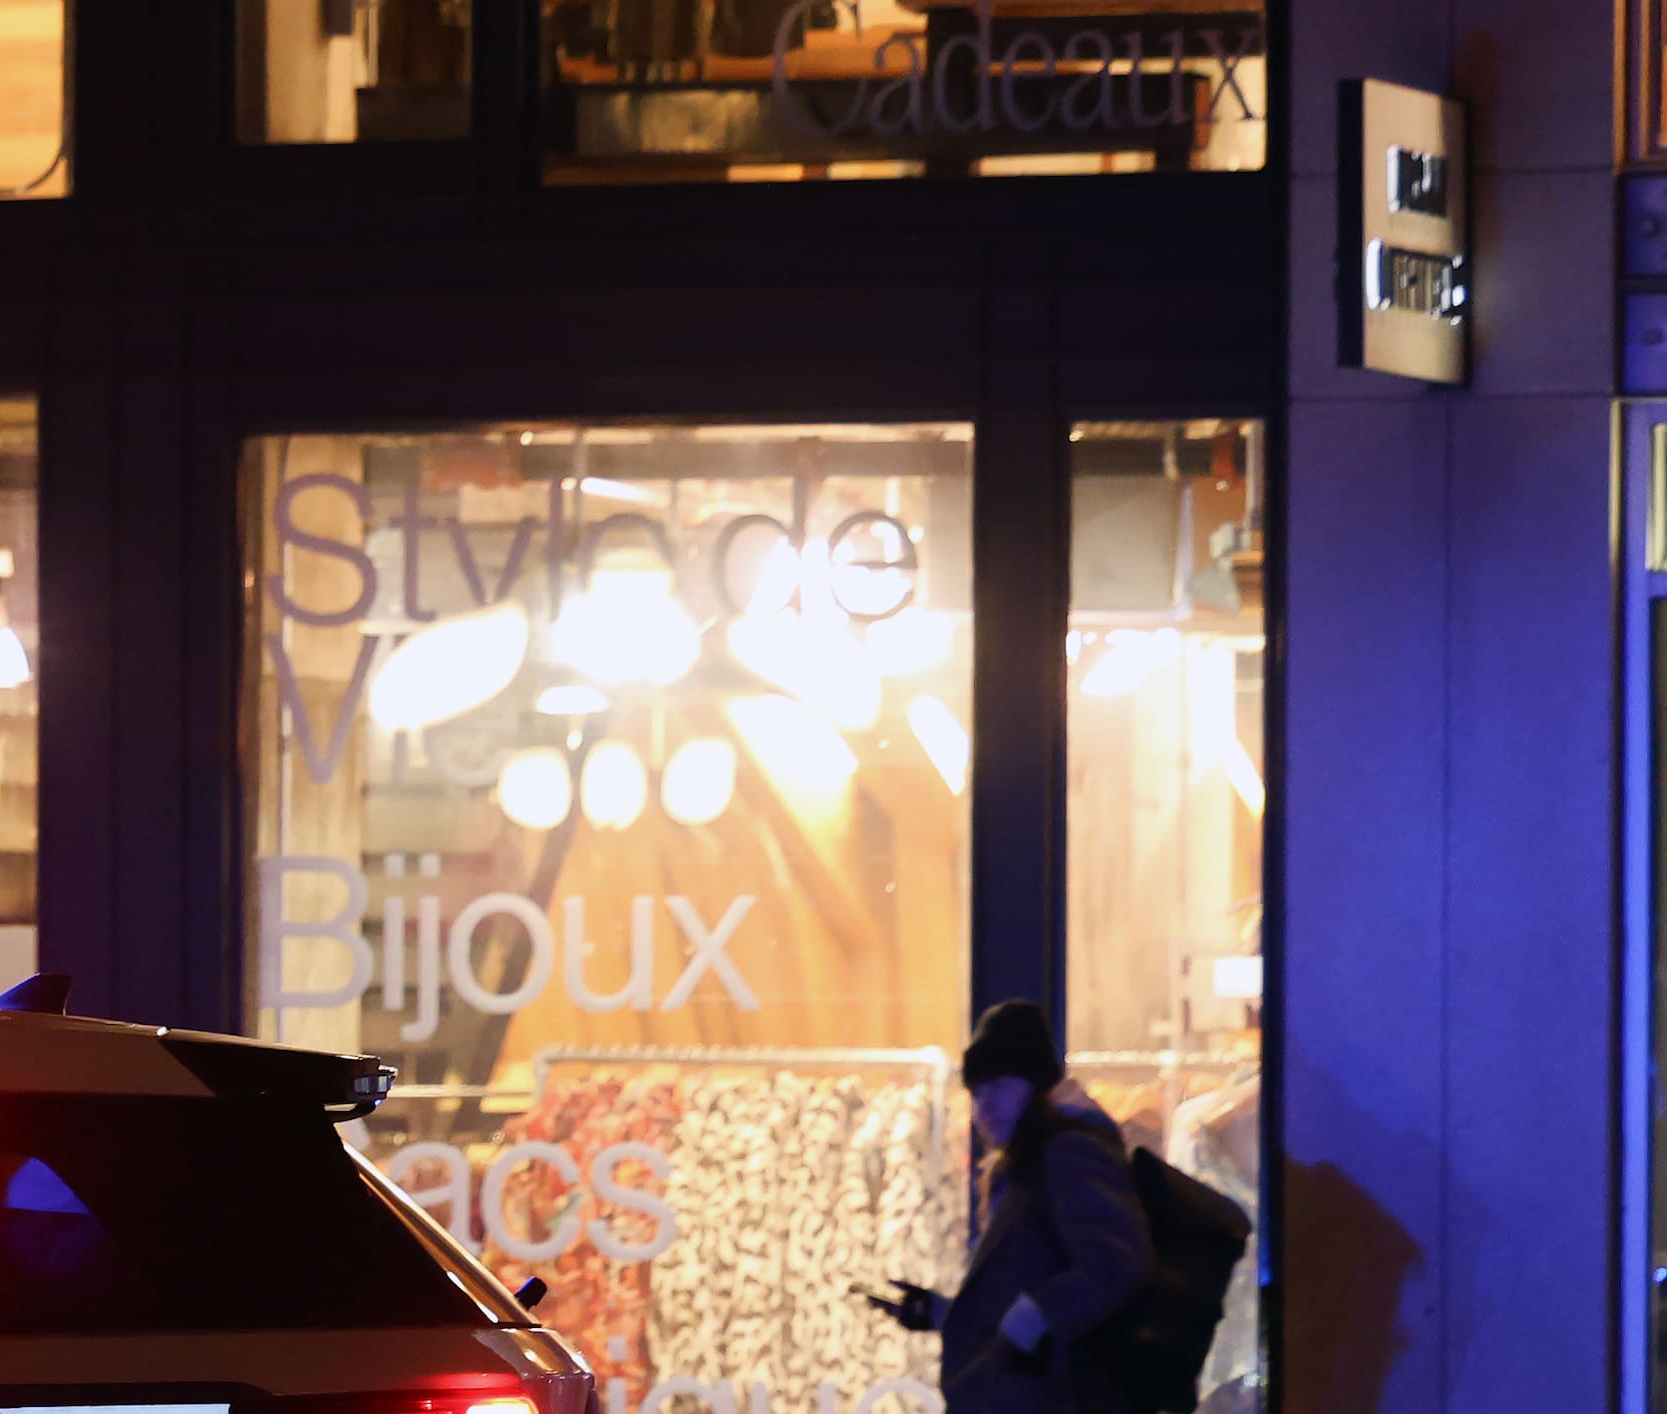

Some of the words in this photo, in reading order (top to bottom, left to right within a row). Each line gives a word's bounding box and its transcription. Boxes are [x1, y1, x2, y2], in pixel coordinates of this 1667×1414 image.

[772, 0, 1266, 138] Cadeaux
[256, 852, 762, 1044] Bijoux
[334, 1098, 678, 1262] acs
